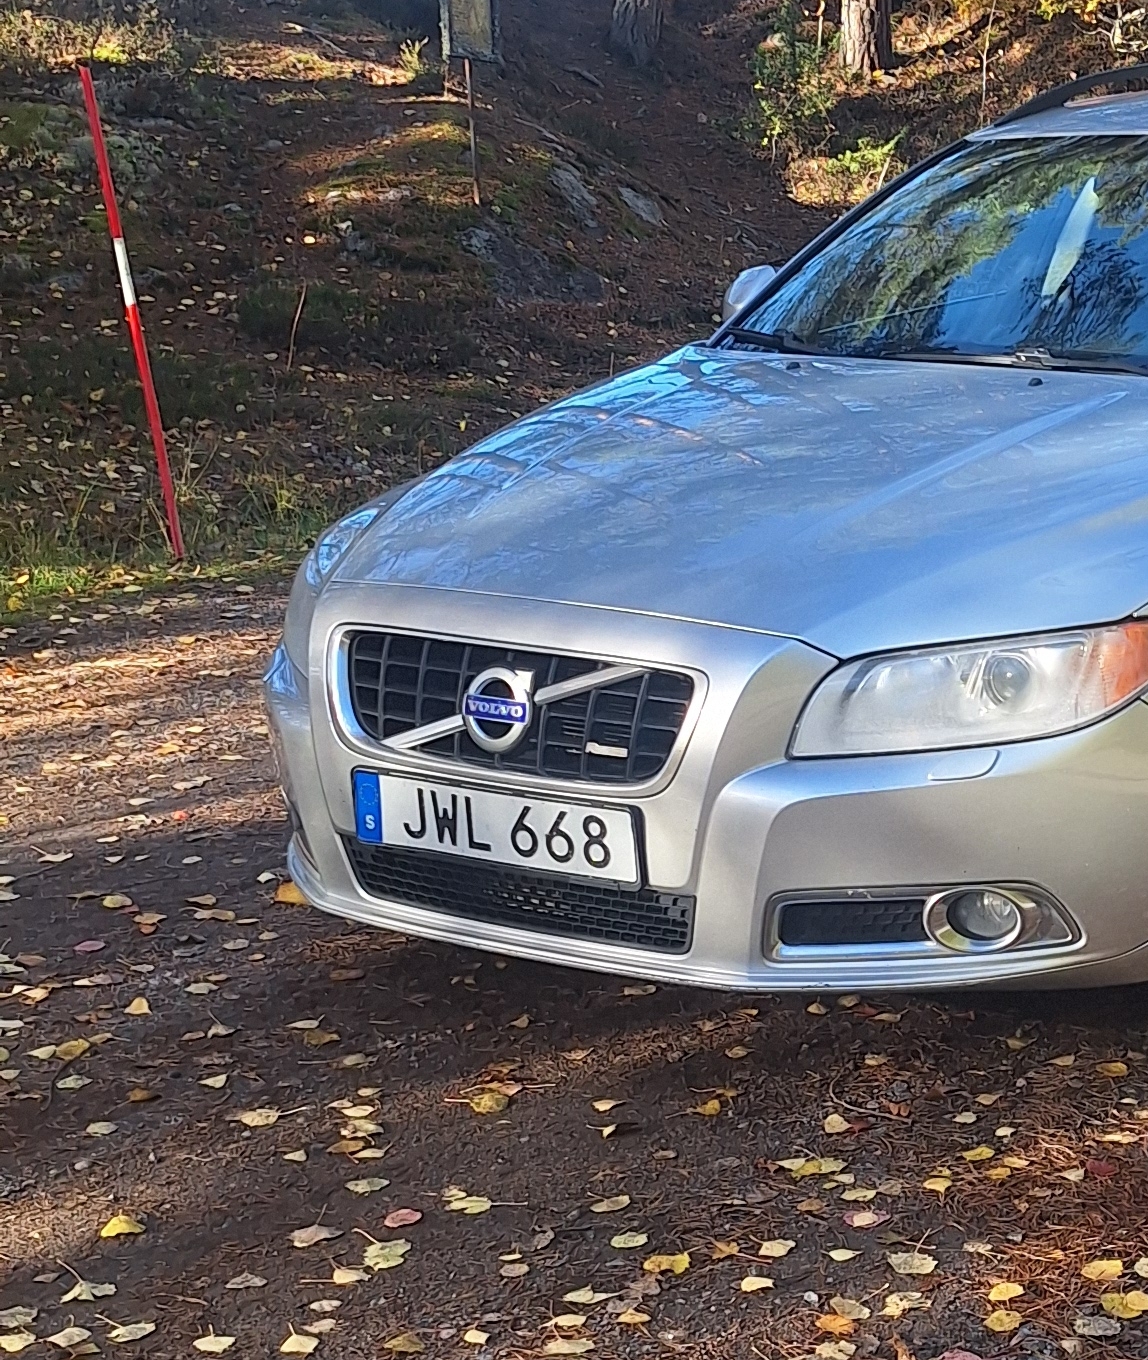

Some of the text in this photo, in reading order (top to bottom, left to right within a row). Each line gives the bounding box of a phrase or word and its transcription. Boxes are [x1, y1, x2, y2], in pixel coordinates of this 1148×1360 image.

[467, 699, 524, 718] VOLVO
[365, 814, 376, 830] S
[403, 788, 611, 869] JWL 668
